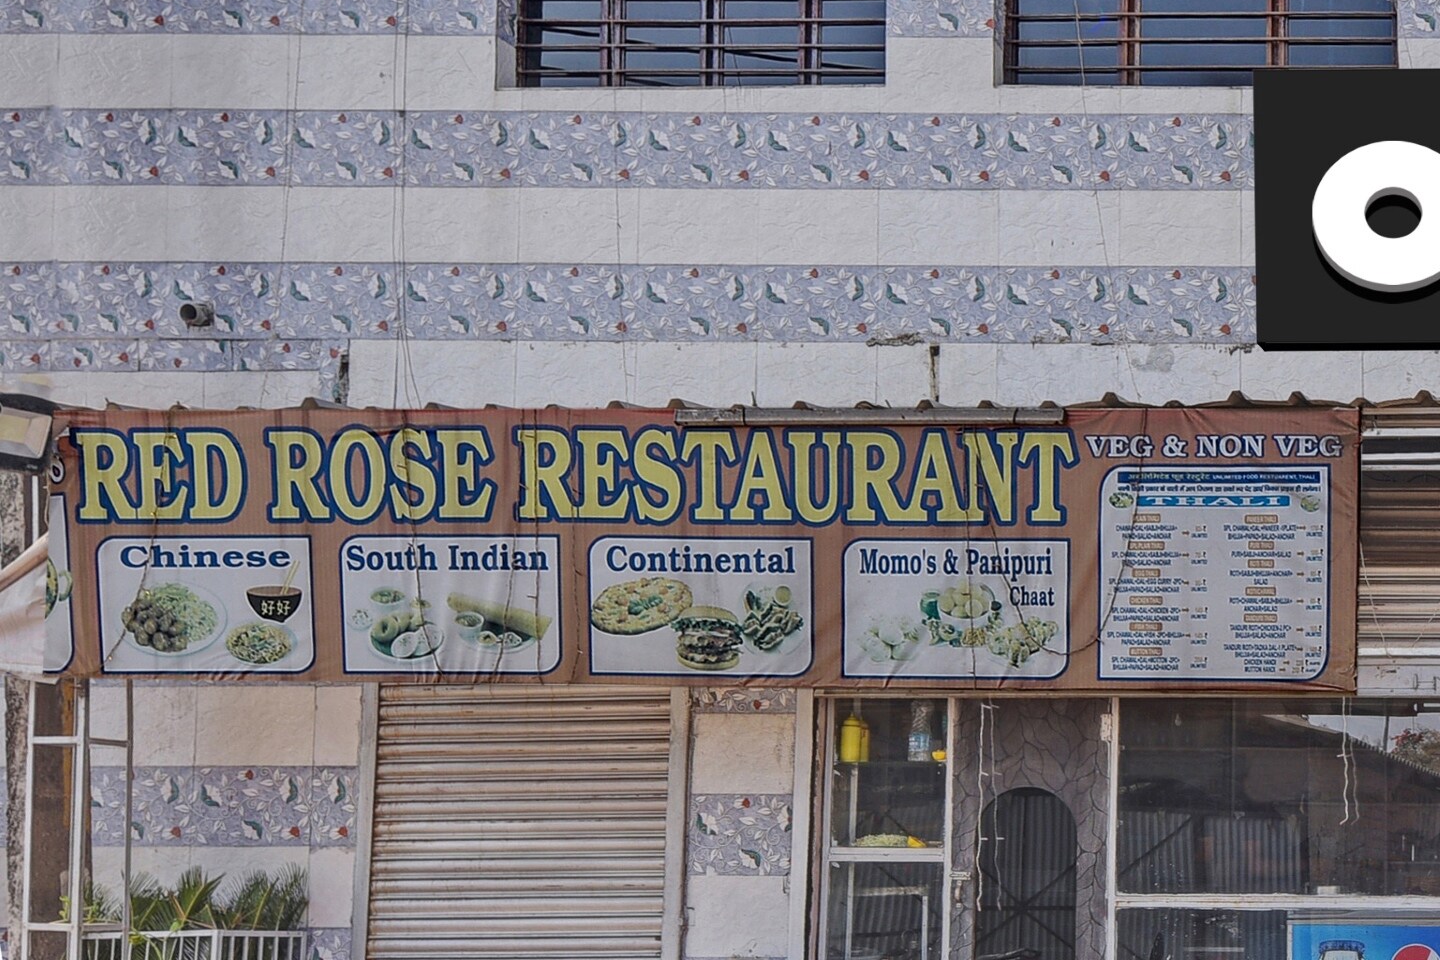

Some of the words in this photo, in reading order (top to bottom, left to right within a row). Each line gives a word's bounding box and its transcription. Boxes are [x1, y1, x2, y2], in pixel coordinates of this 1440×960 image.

[1085, 434, 1154, 458] VEG
[1161, 434, 1190, 458] &
[1195, 434, 1266, 458] NON
[1272, 435, 1344, 458] VEG
[73, 426, 249, 522] RED
[264, 424, 500, 523] ROSE
[513, 428, 1078, 526] RESTAURANT
[1146, 497, 1281, 506] THALI
[120, 544, 292, 569] Chinese
[346, 545, 437, 572] South
[448, 545, 549, 572] Indian
[606, 545, 796, 573] Continental
[859, 548, 937, 575] Momo's
[943, 548, 959, 575] &
[966, 547, 1052, 581] Panipuri
[261, 600, 291, 615] 好好
[1010, 586, 1055, 606] Chaat
